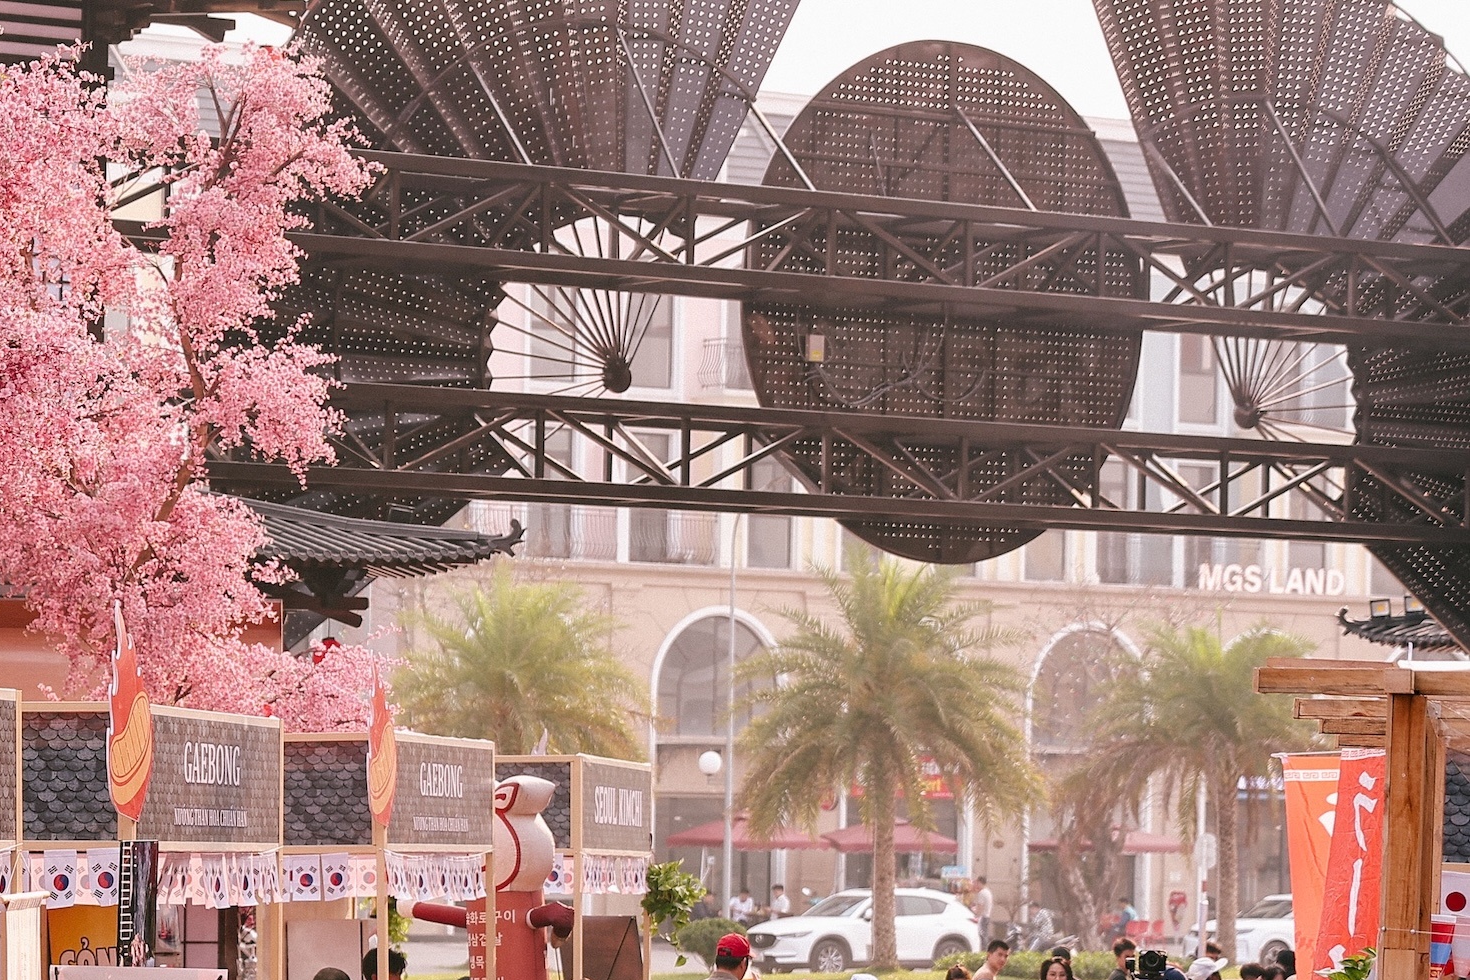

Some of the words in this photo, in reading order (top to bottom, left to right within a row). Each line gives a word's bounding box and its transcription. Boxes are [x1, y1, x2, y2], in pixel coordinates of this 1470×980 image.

[1198, 562, 1262, 593] MGS
[1268, 567, 1345, 596] LAND
[184, 741, 241, 786] GAEBONG
[420, 762, 463, 798] GAEBONG
[594, 785, 618, 825] SEOUL
[618, 788, 643, 828] KIMCHI
